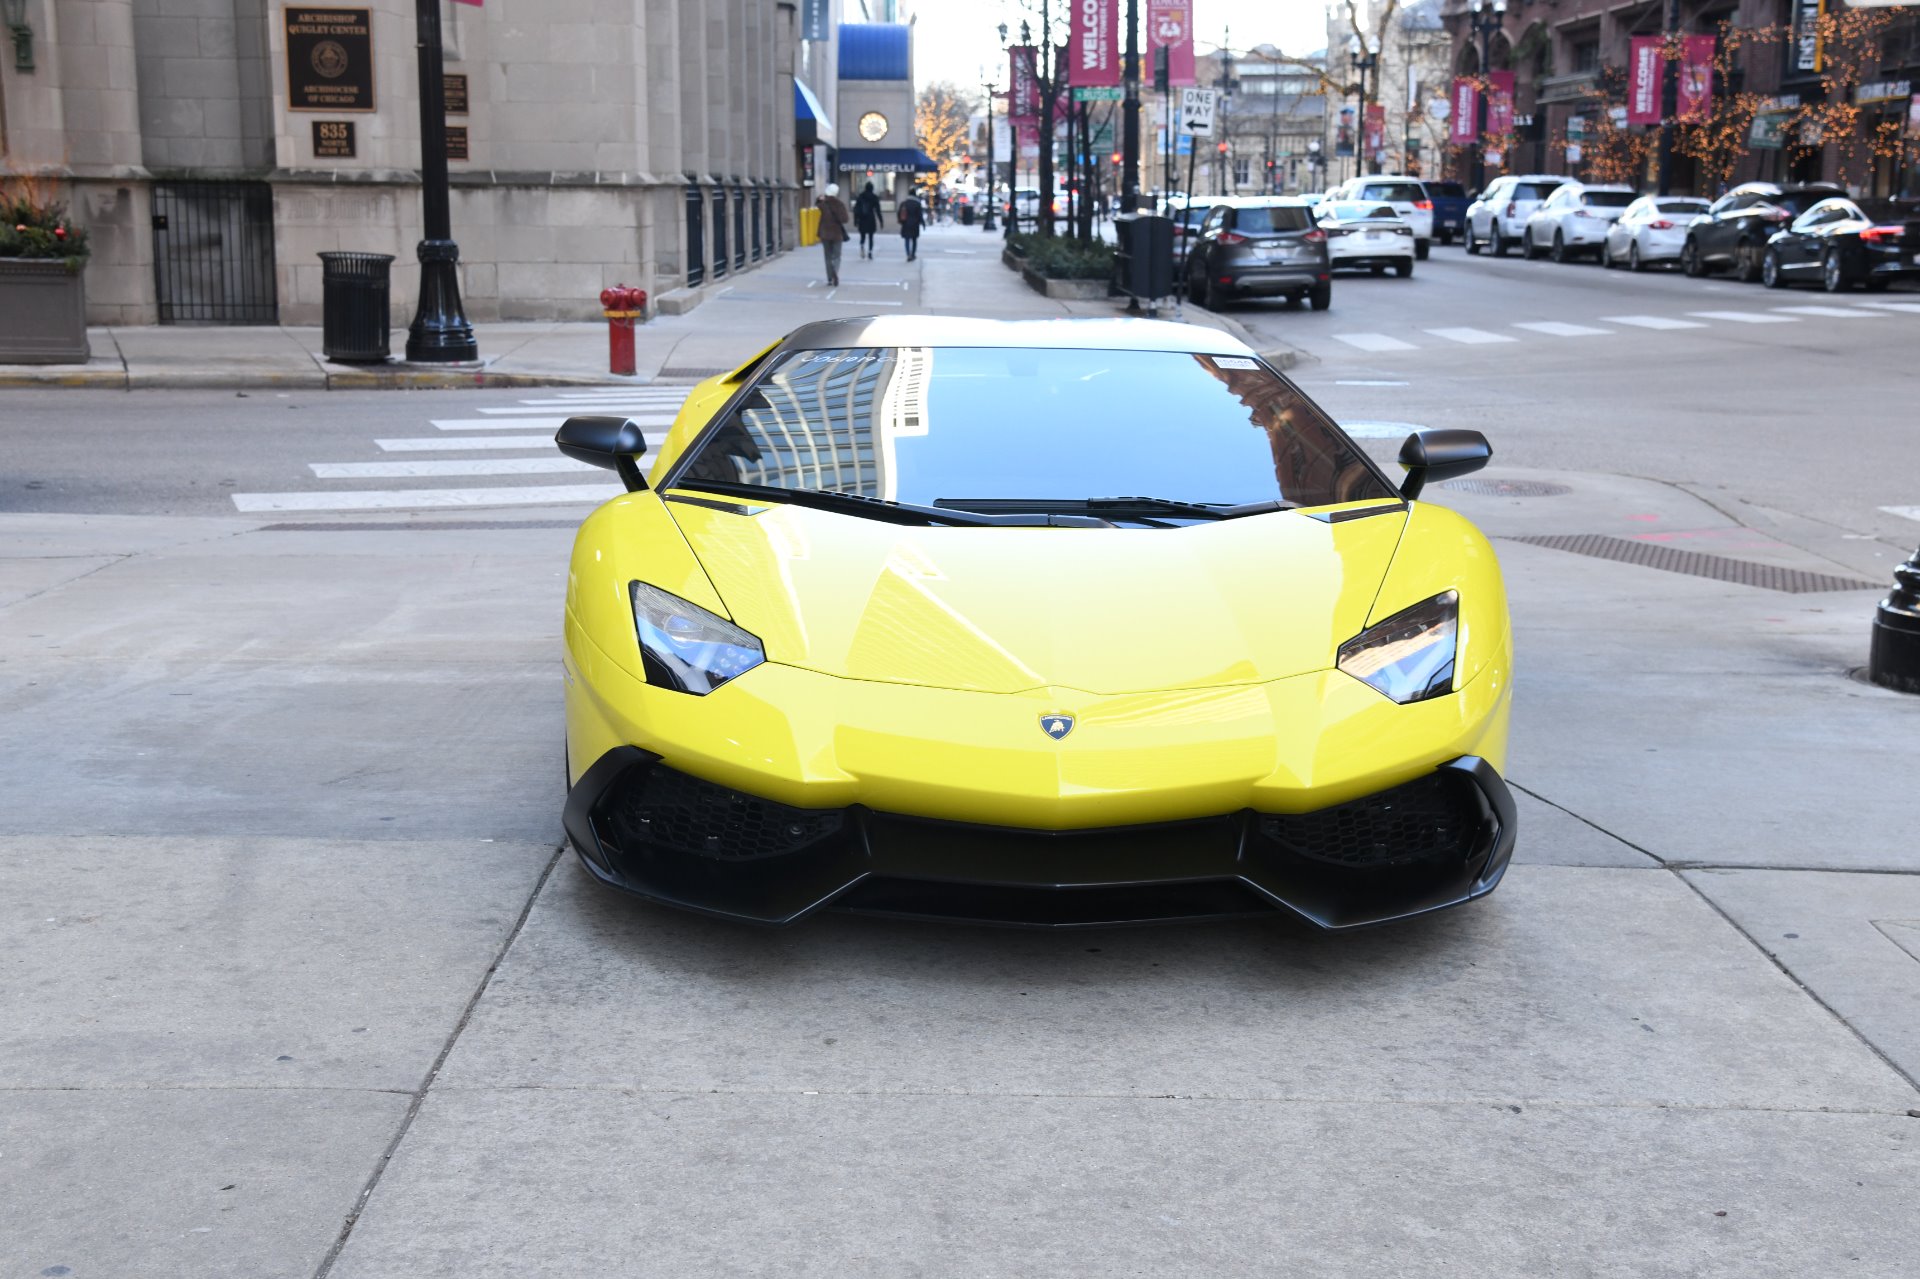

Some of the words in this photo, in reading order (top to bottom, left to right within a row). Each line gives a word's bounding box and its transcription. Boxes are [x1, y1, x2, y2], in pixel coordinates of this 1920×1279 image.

[298, 14, 357, 23] ARCHBISHOP
[1100, 7, 1108, 38] TOWER
[288, 24, 329, 35] QUIGLEY
[330, 25, 367, 35] CENTER
[1100, 40, 1108, 70] WATER
[1636, 47, 1648, 114] WELCOME
[308, 94, 318, 103] OF
[320, 95, 356, 103] CHICAGO
[1083, 88, 1109, 99] RUSH
[1186, 91, 1212, 104] ONE
[1185, 105, 1211, 117] WAY
[1458, 86, 1467, 135] WELCOME
[320, 123, 347, 139] 835
[839, 163, 915, 172] GHIRARDELLI
